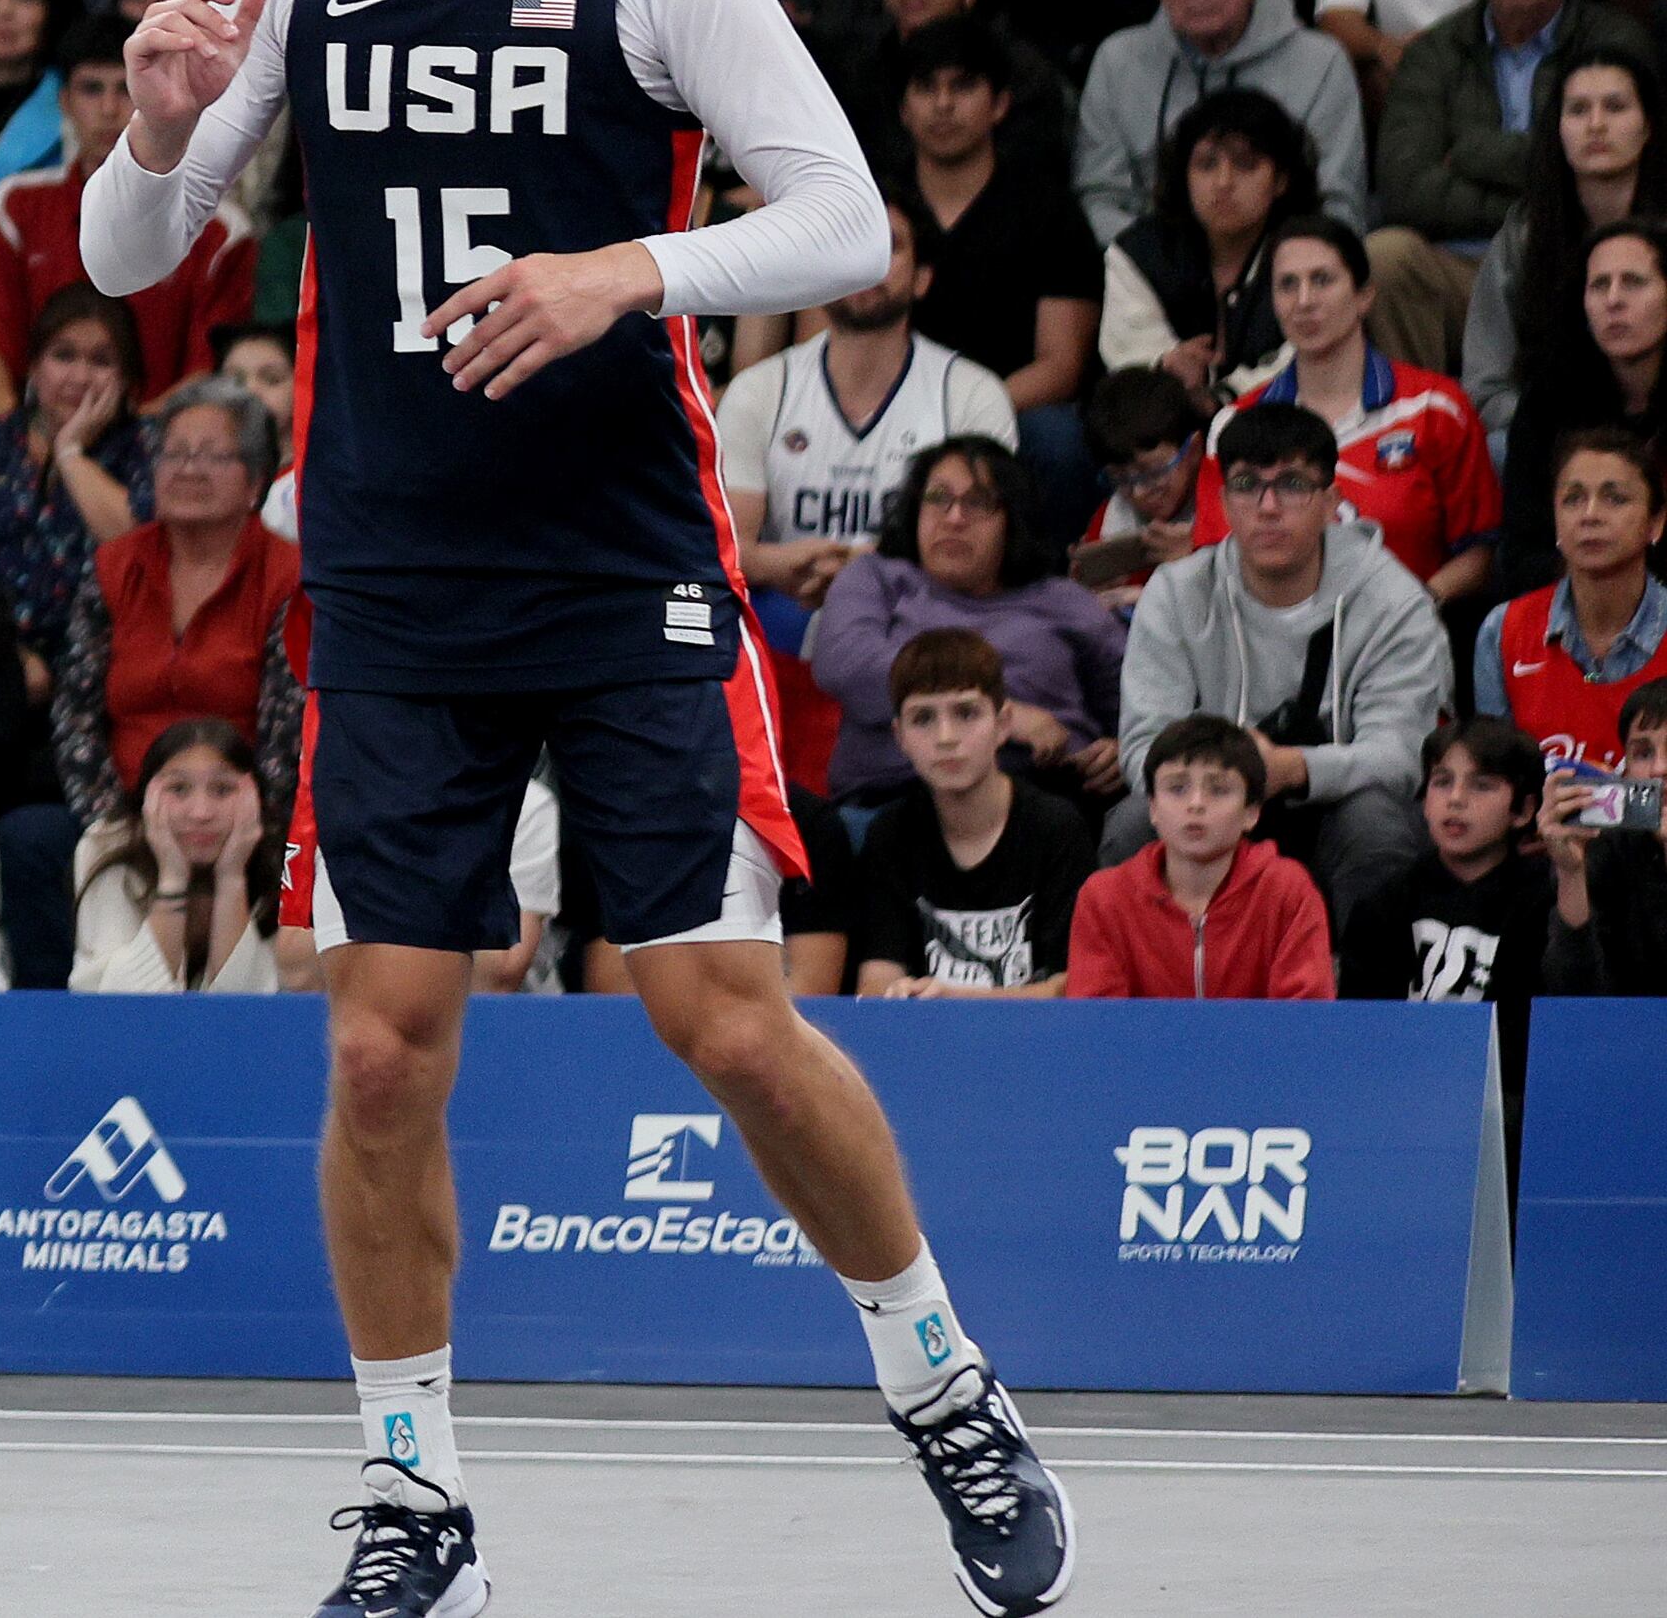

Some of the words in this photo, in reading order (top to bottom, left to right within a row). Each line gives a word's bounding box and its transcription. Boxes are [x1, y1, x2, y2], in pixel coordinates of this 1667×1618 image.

[326, 43, 569, 135] USA
[384, 187, 513, 352] 15
[793, 487, 884, 534] CHIL
[673, 583, 704, 599] 46
[1113, 1126, 1312, 1186] BOR
[1119, 1184, 1308, 1243] NAN
[22, 1240, 190, 1273] MINERALS
[1118, 1244, 1183, 1262] SPORTS
[1189, 1244, 1301, 1262] TECHNOLOGY
